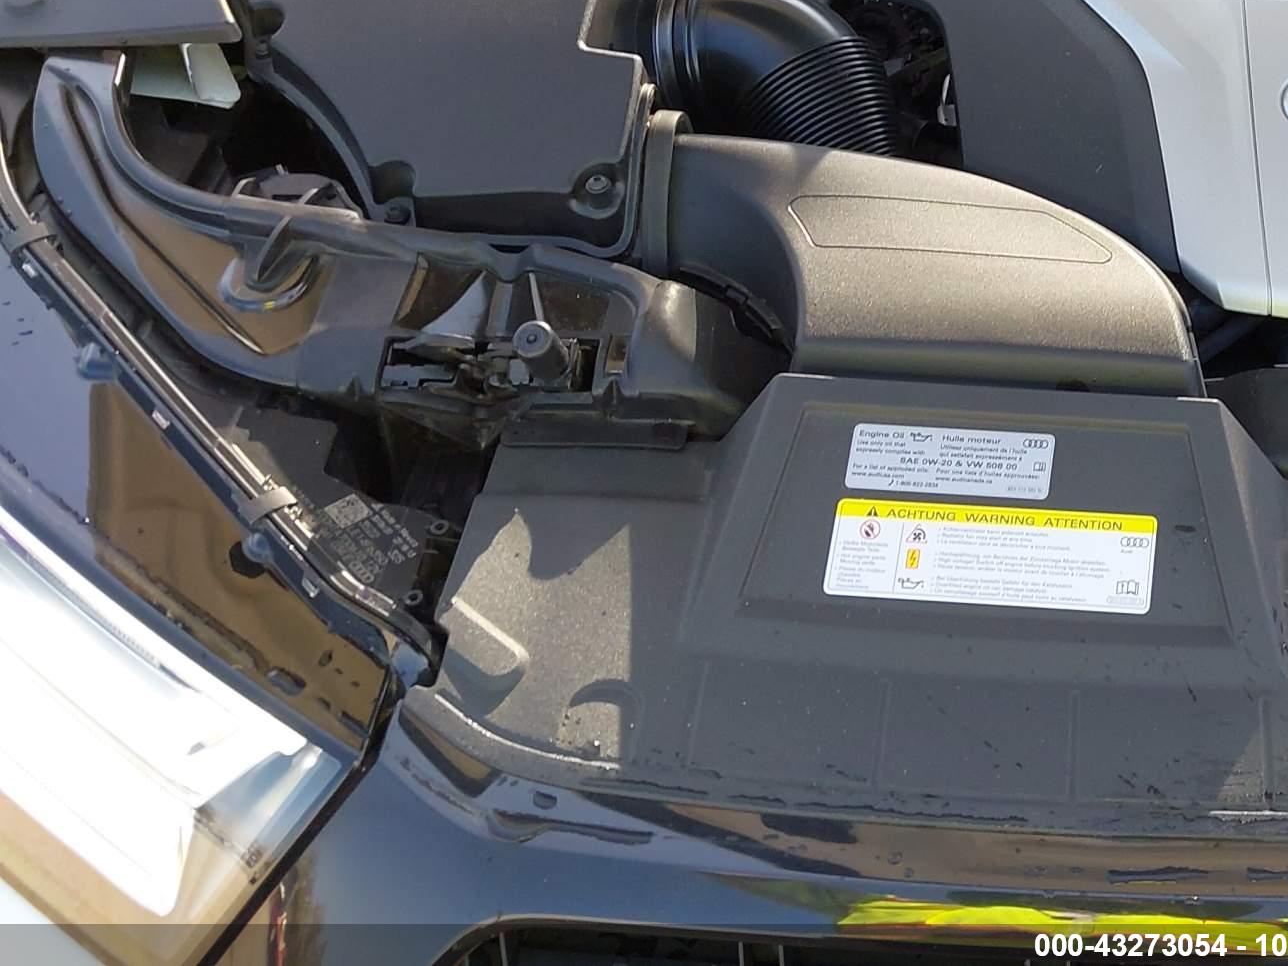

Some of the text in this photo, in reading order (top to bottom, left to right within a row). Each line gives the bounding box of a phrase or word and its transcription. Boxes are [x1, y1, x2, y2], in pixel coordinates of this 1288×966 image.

[859, 430, 905, 439] Engine Oil
[967, 436, 1001, 444] moteur
[900, 457, 919, 465] SAE
[966, 461, 983, 469] VW
[1006, 463, 1018, 471] 00
[886, 508, 1123, 530] ACHTUNG WARNING ATTENTION
